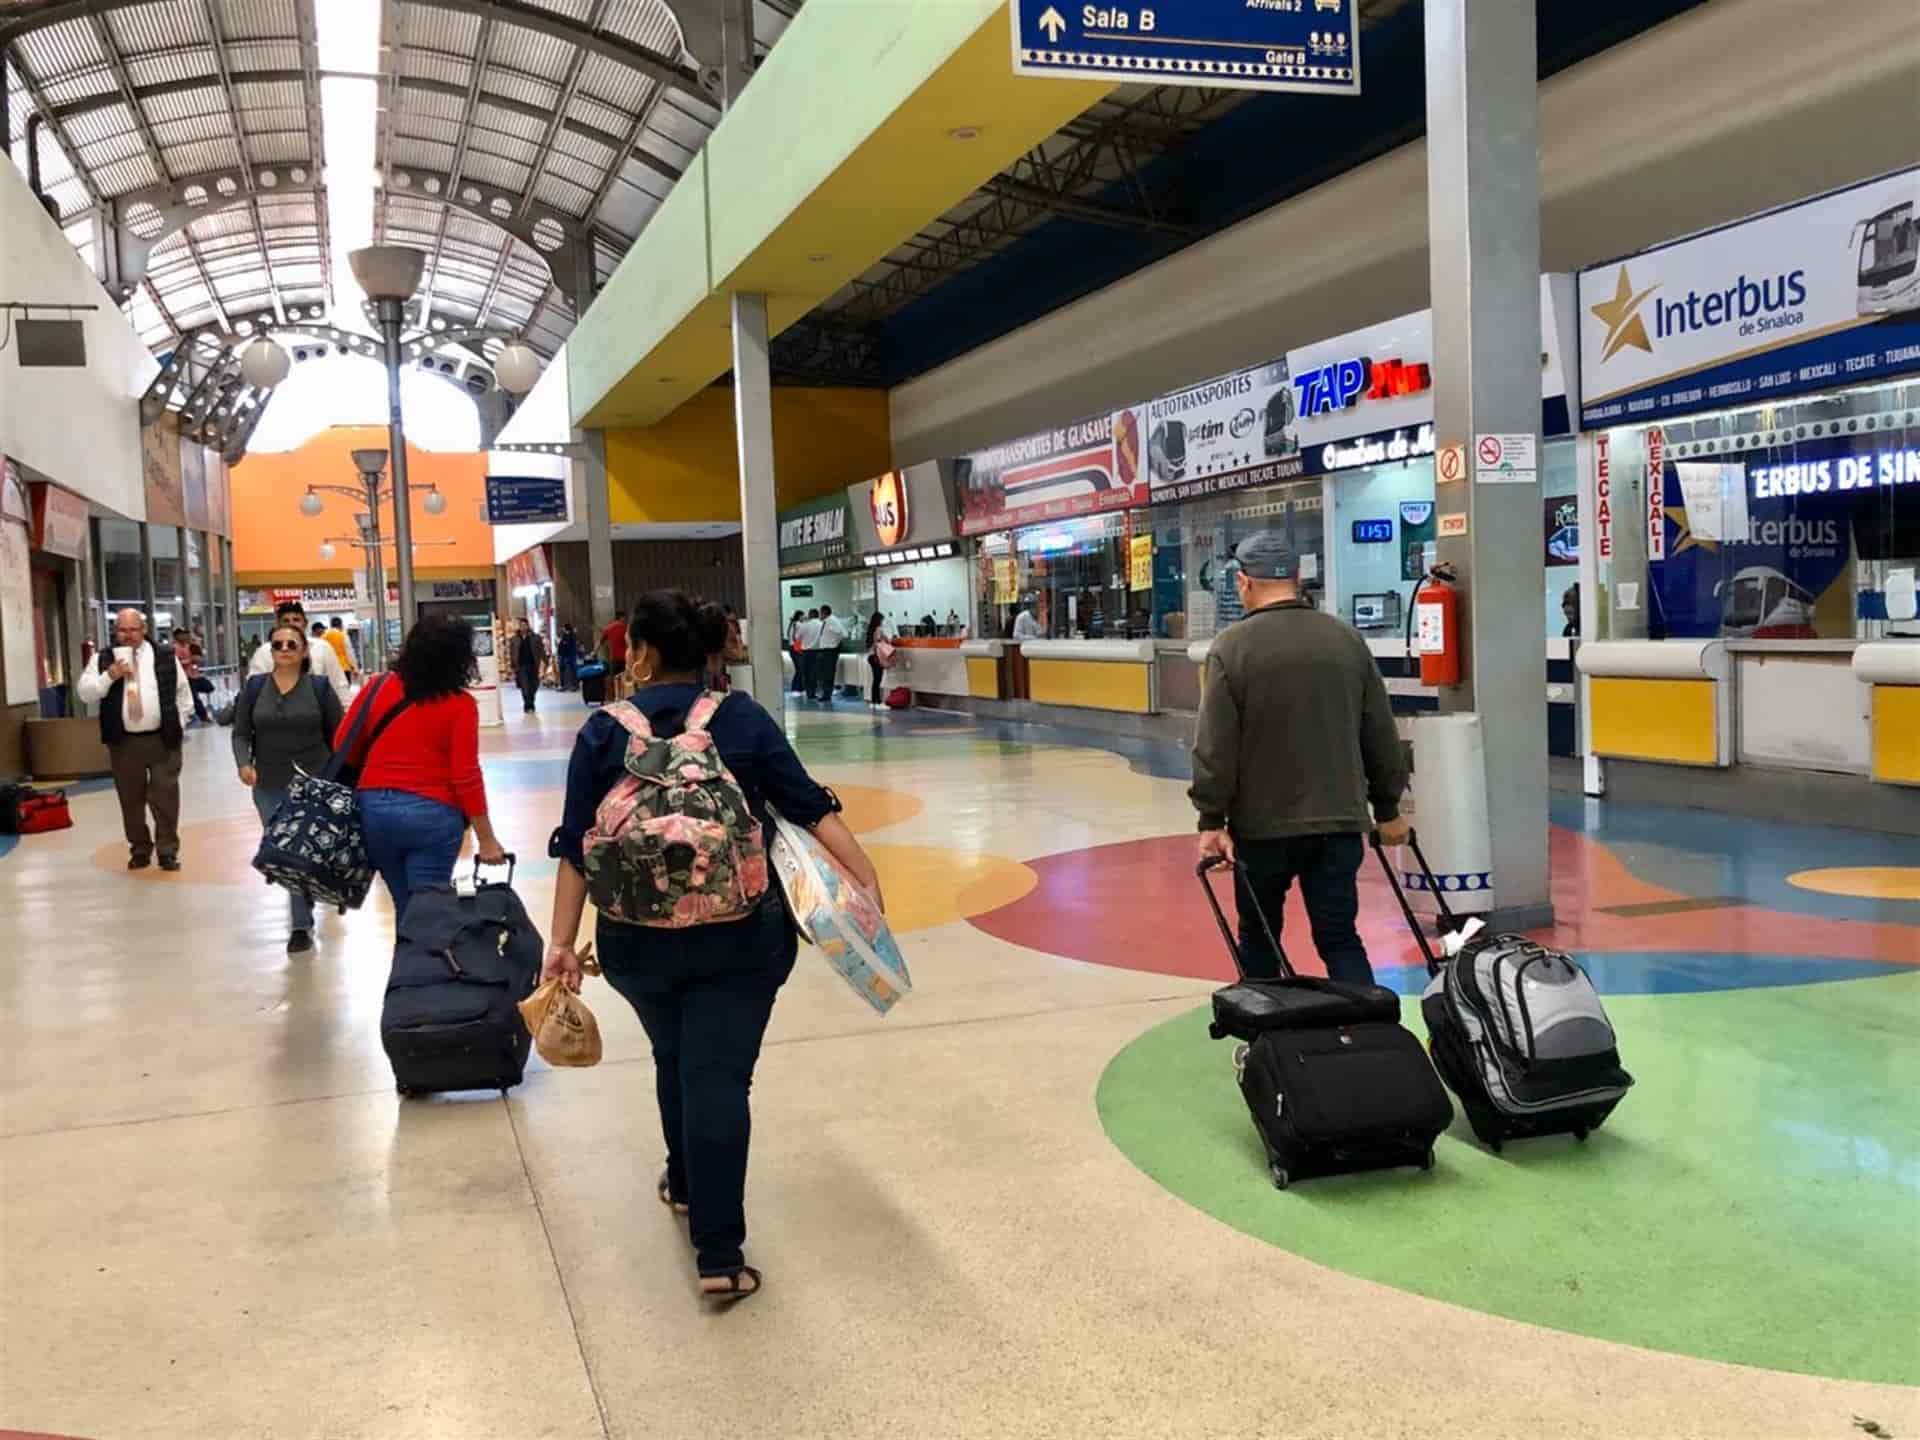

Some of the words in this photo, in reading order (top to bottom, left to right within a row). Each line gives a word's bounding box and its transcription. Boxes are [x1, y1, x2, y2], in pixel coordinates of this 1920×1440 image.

[1082, 6, 1129, 30] Sala
[1139, 10, 1155, 32] B
[1265, 50, 1295, 64] Gate
[1655, 269, 1807, 338] Interbus
[1739, 322, 1755, 336] de
[1757, 311, 1803, 333] Sinaloa
[1845, 353, 1876, 372] TECATE
[1151, 374, 1252, 419] AUTOTRANSPORTES
[1294, 357, 1364, 419] TAP
[1053, 429, 1066, 451] DE
[1067, 416, 1112, 448] GUASAVE
[1387, 430, 1408, 460] de
[1837, 456, 1873, 490] DE
[1596, 435, 1612, 557] TECATE
[1647, 430, 1663, 553] MEXICALI
